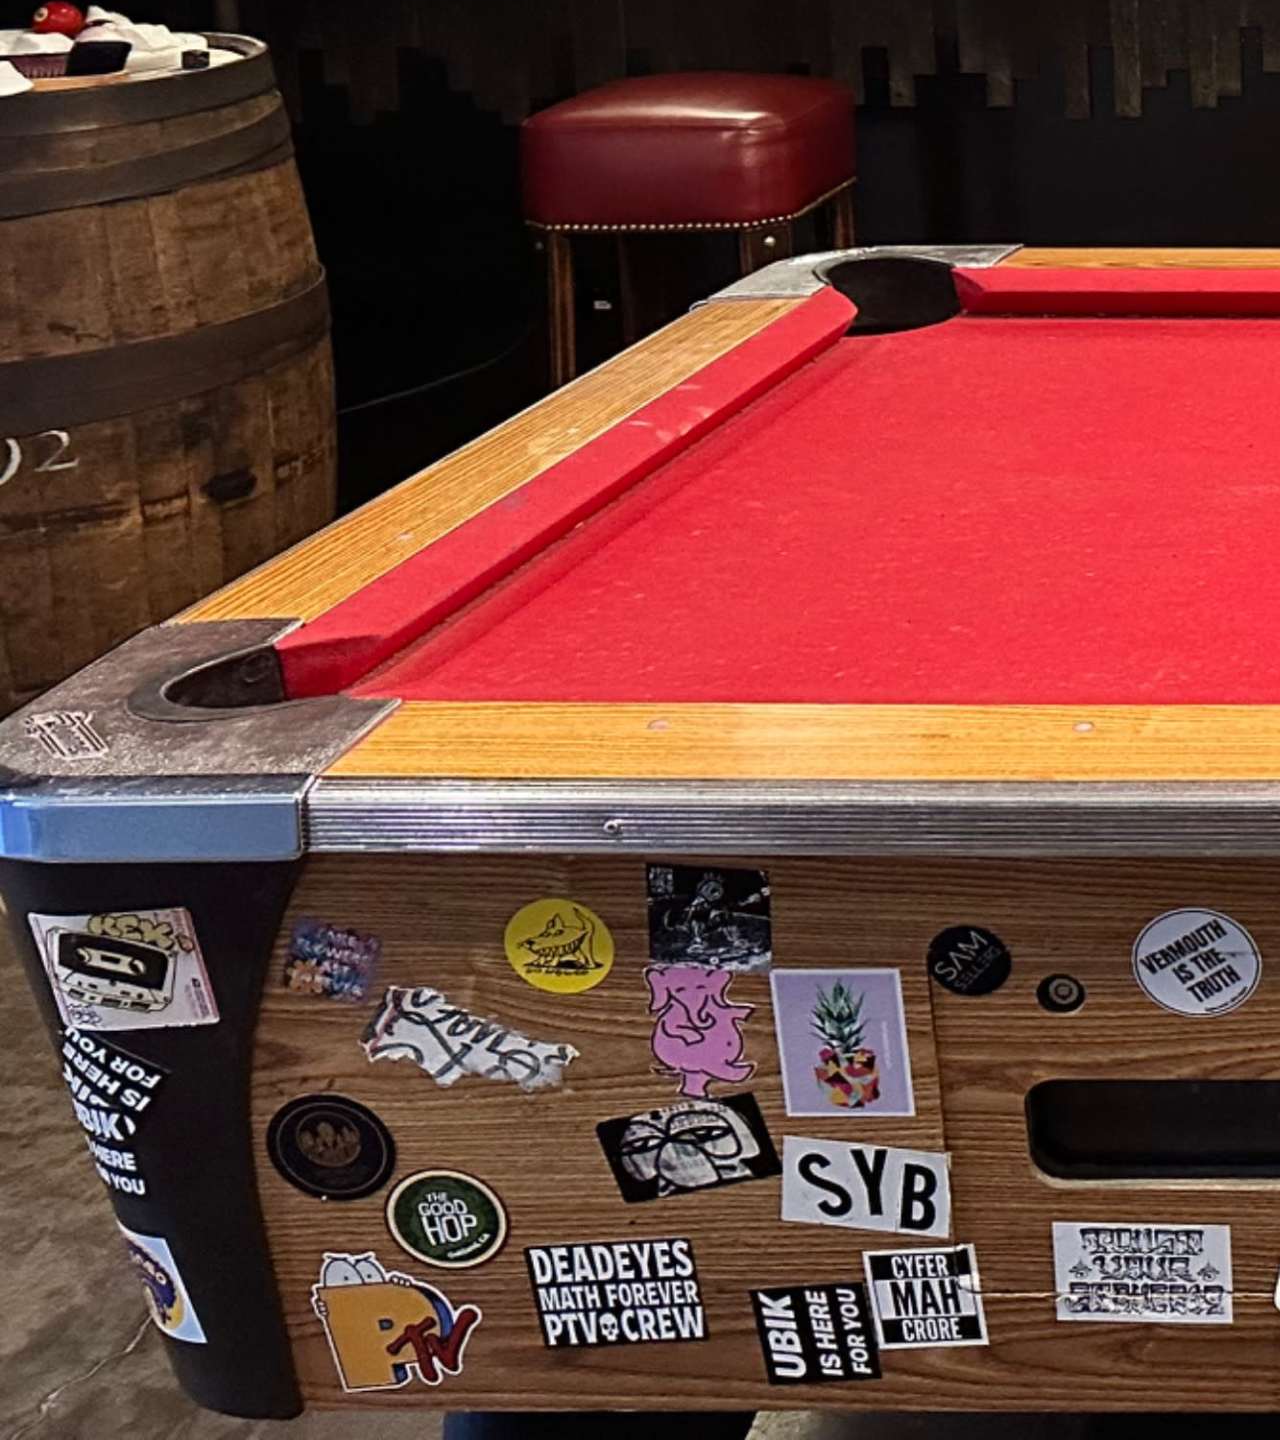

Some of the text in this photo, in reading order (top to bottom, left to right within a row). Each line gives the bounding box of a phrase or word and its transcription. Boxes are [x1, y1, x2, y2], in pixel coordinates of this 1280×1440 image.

[934, 929, 989, 981] SAM
[1139, 918, 1228, 976] VERMOUTH
[1173, 947, 1227, 985] IS THE
[1187, 965, 1241, 1003] TRUTH
[62, 1041, 151, 1112] HERE IS
[64, 1025, 162, 1089] YOU FOR
[110, 1172, 146, 1196] YOU
[426, 1192, 448, 1203] THE
[797, 1148, 938, 1231] SYB
[417, 1199, 468, 1217] GOOD
[421, 1214, 478, 1247] HOP
[529, 1239, 693, 1285] DEADEYES
[890, 1255, 950, 1281] CYFER
[537, 1281, 701, 1312] MATH FOREVER
[890, 1279, 961, 1318] MAH
[543, 1306, 705, 1346] PTV CREW
[757, 1291, 809, 1380] UBIK
[804, 1288, 846, 1377] IS HERE
[836, 1288, 874, 1375] FOR YOU
[901, 1317, 964, 1343] CRORE
